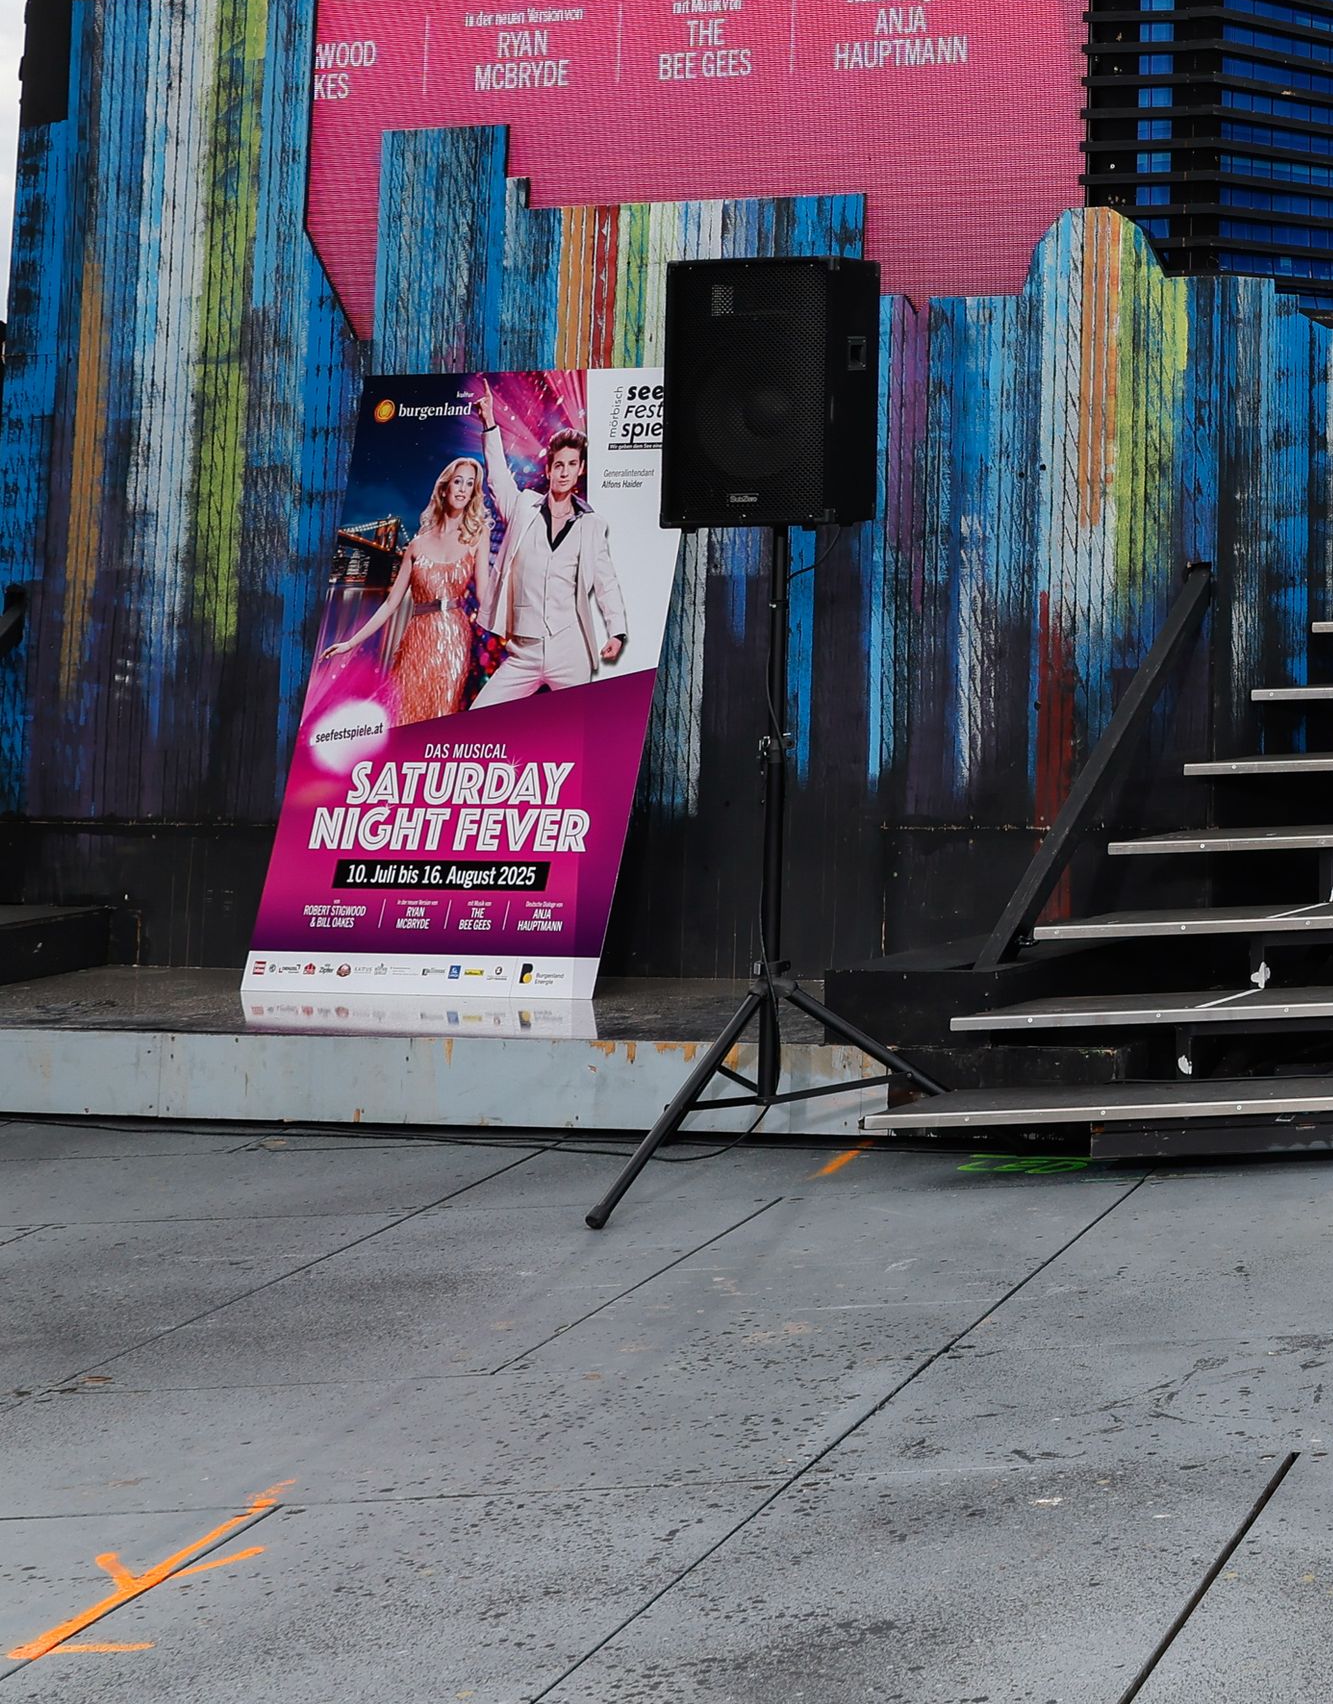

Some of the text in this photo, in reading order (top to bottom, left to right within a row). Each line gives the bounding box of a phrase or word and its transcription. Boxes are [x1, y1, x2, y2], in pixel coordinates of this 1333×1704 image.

[475, 10, 494, 27] der
[495, 9, 525, 25] neuen
[527, 7, 564, 24] Version
[565, 7, 584, 21] von
[874, 6, 927, 35] ANJA
[686, 18, 726, 47] THE
[497, 30, 549, 58] RYAN
[834, 35, 969, 70] HAUPTMANN
[315, 41, 376, 69] WOOD
[658, 49, 752, 80] BEE GEES
[474, 59, 571, 91] MCBRYDE
[314, 73, 350, 100] KES
[627, 385, 664, 401] see
[398, 401, 473, 421] burgenland
[609, 386, 623, 438] mörbisch
[621, 422, 663, 444] spie
[603, 468, 655, 478] Generalintendant
[601, 479, 643, 489] Alfons Haider
[315, 722, 383, 744] seefestspiele.at
[424, 743, 508, 759] DAS MUSICAL
[346, 761, 575, 805] SATURDAY
[308, 805, 591, 853] NIGHT FEVER
[346, 864, 536, 889] 10. Juli bis 16. August 2025
[303, 905, 366, 917] ROBERT STIGWOOD
[406, 906, 425, 917] RYAN
[471, 907, 485, 918] THE
[532, 909, 551, 919] ANJA
[310, 916, 355, 928] & BILL OAKES
[396, 918, 431, 929] MCBRYDE
[458, 919, 491, 931] BEE GEES
[517, 921, 563, 932] HAUPTMANN
